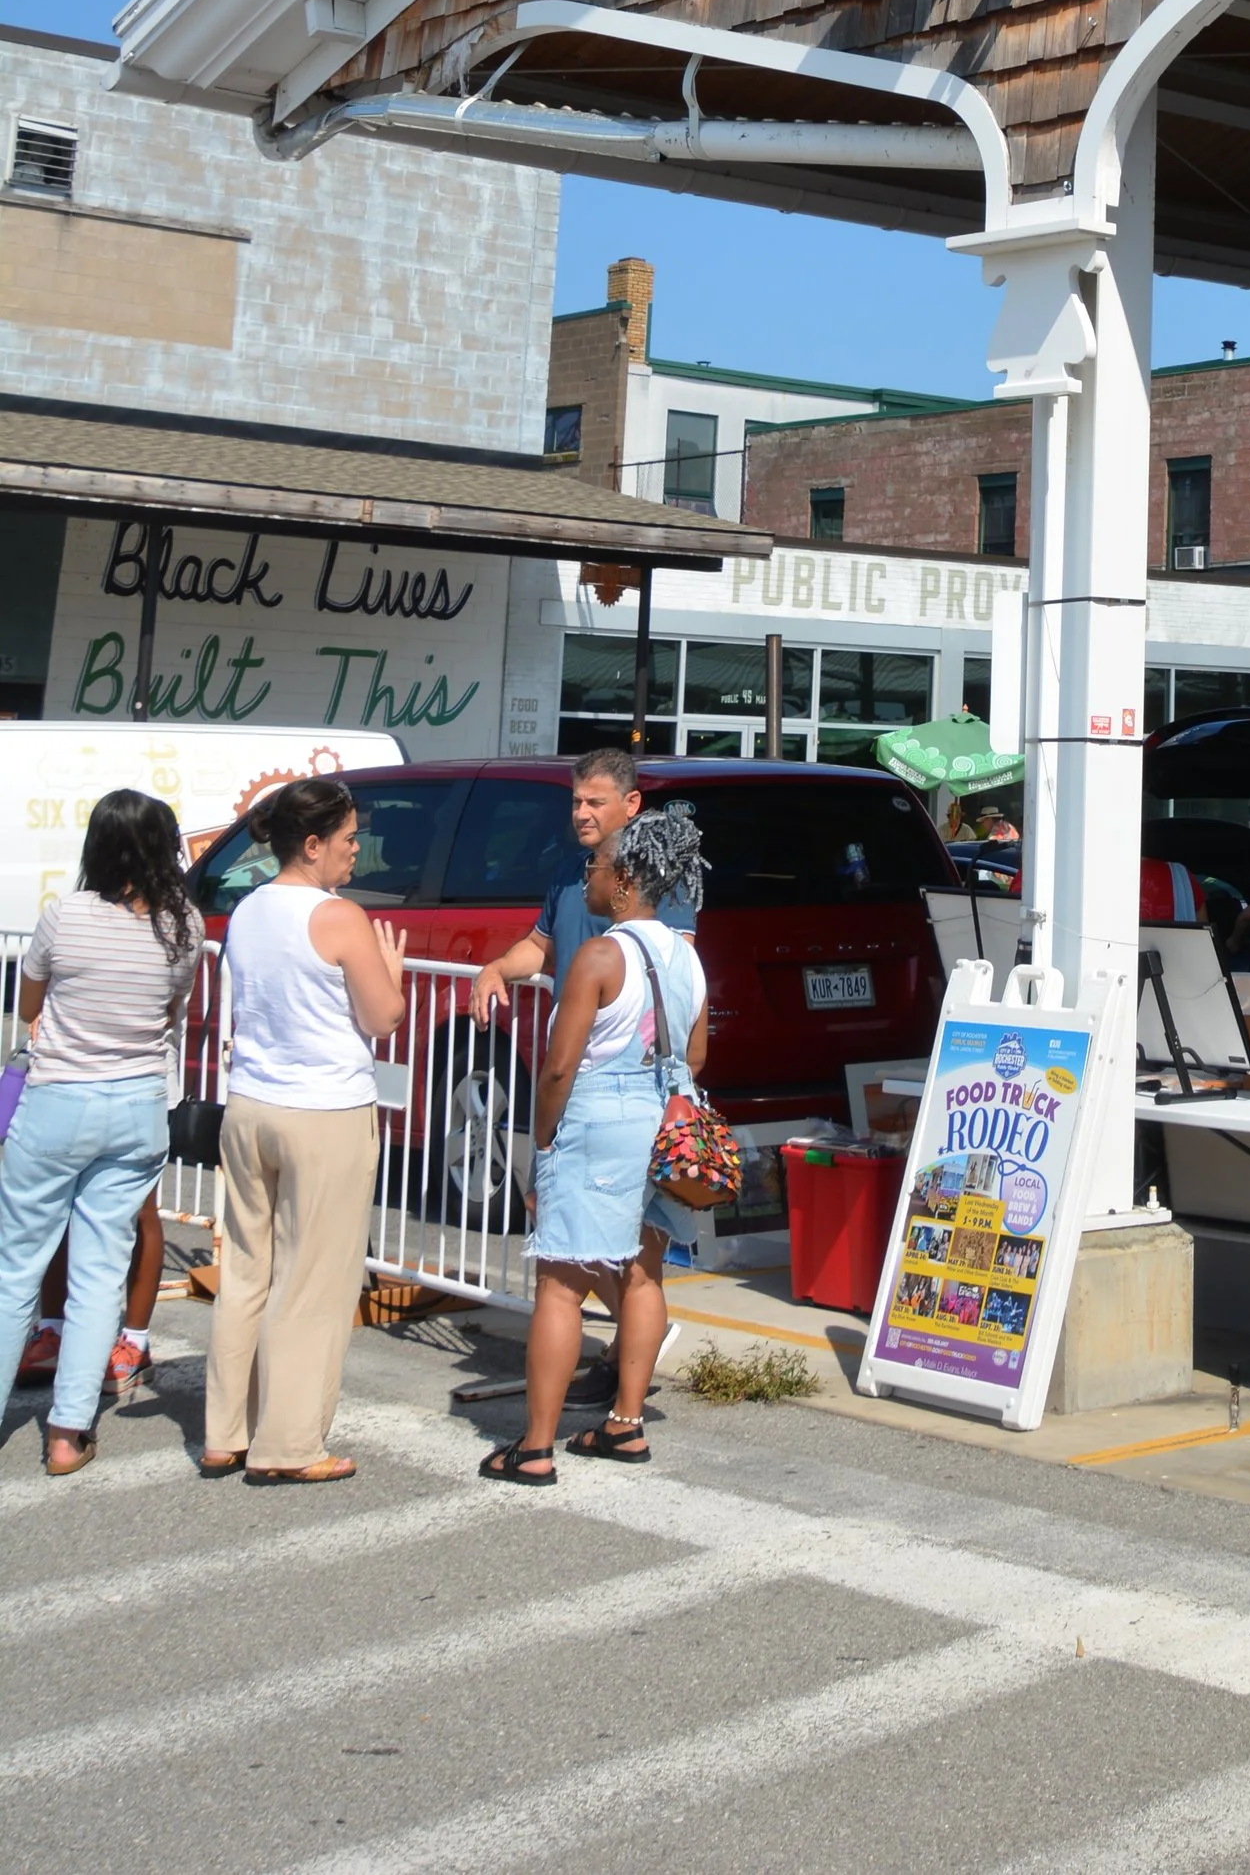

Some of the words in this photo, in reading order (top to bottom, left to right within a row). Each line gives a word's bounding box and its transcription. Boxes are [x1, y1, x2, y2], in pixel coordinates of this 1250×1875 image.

[101, 521, 283, 608] Black
[315, 539, 474, 620] Lives
[732, 554, 887, 614] PUBLIC
[72, 631, 271, 721] Built
[316, 646, 480, 728] This
[510, 697, 538, 712] FOOD
[721, 694, 739, 704] PUBLIC
[509, 720, 537, 734] BEER
[26, 798, 66, 829] SIX
[811, 978, 834, 999] KUR
[839, 976, 867, 998] 7849
[994, 1053, 1025, 1067] ROCHESTER
[946, 1081, 996, 1111] FOOD
[1001, 1080, 1062, 1123] TRUCK
[942, 1107, 1050, 1163] RODEO
[1014, 1176, 1041, 1189] LOCAL
[1008, 1200, 1030, 1213] BREW
[1007, 1213, 1033, 1227] BANDS
